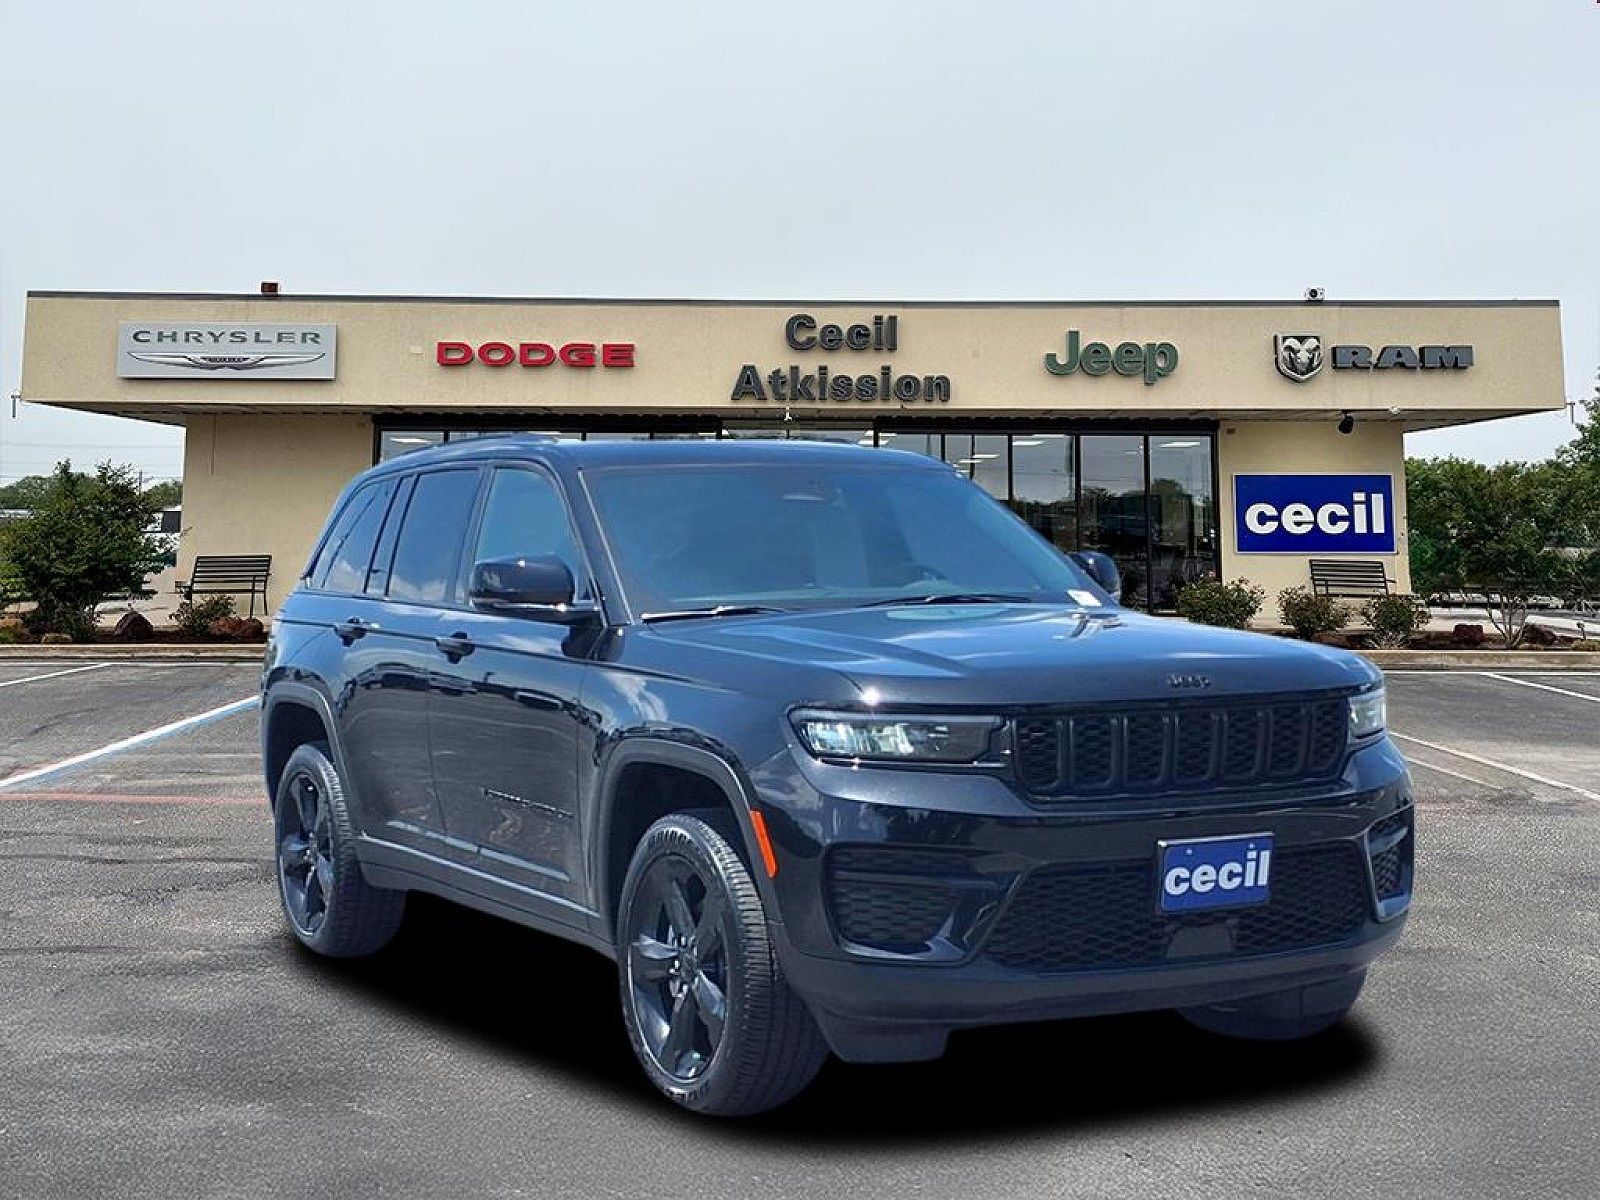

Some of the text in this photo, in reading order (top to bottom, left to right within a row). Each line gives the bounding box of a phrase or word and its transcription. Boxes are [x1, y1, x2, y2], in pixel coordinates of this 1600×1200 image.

[132, 329, 322, 346] CHRYSLER
[785, 313, 898, 351] Cecil
[436, 341, 635, 368] DODGE
[1045, 330, 1179, 386] Jeep
[1333, 345, 1474, 370] RAM
[731, 364, 951, 402] Atkission
[1245, 492, 1385, 534] cecil
[1164, 849, 1271, 896] cecil
